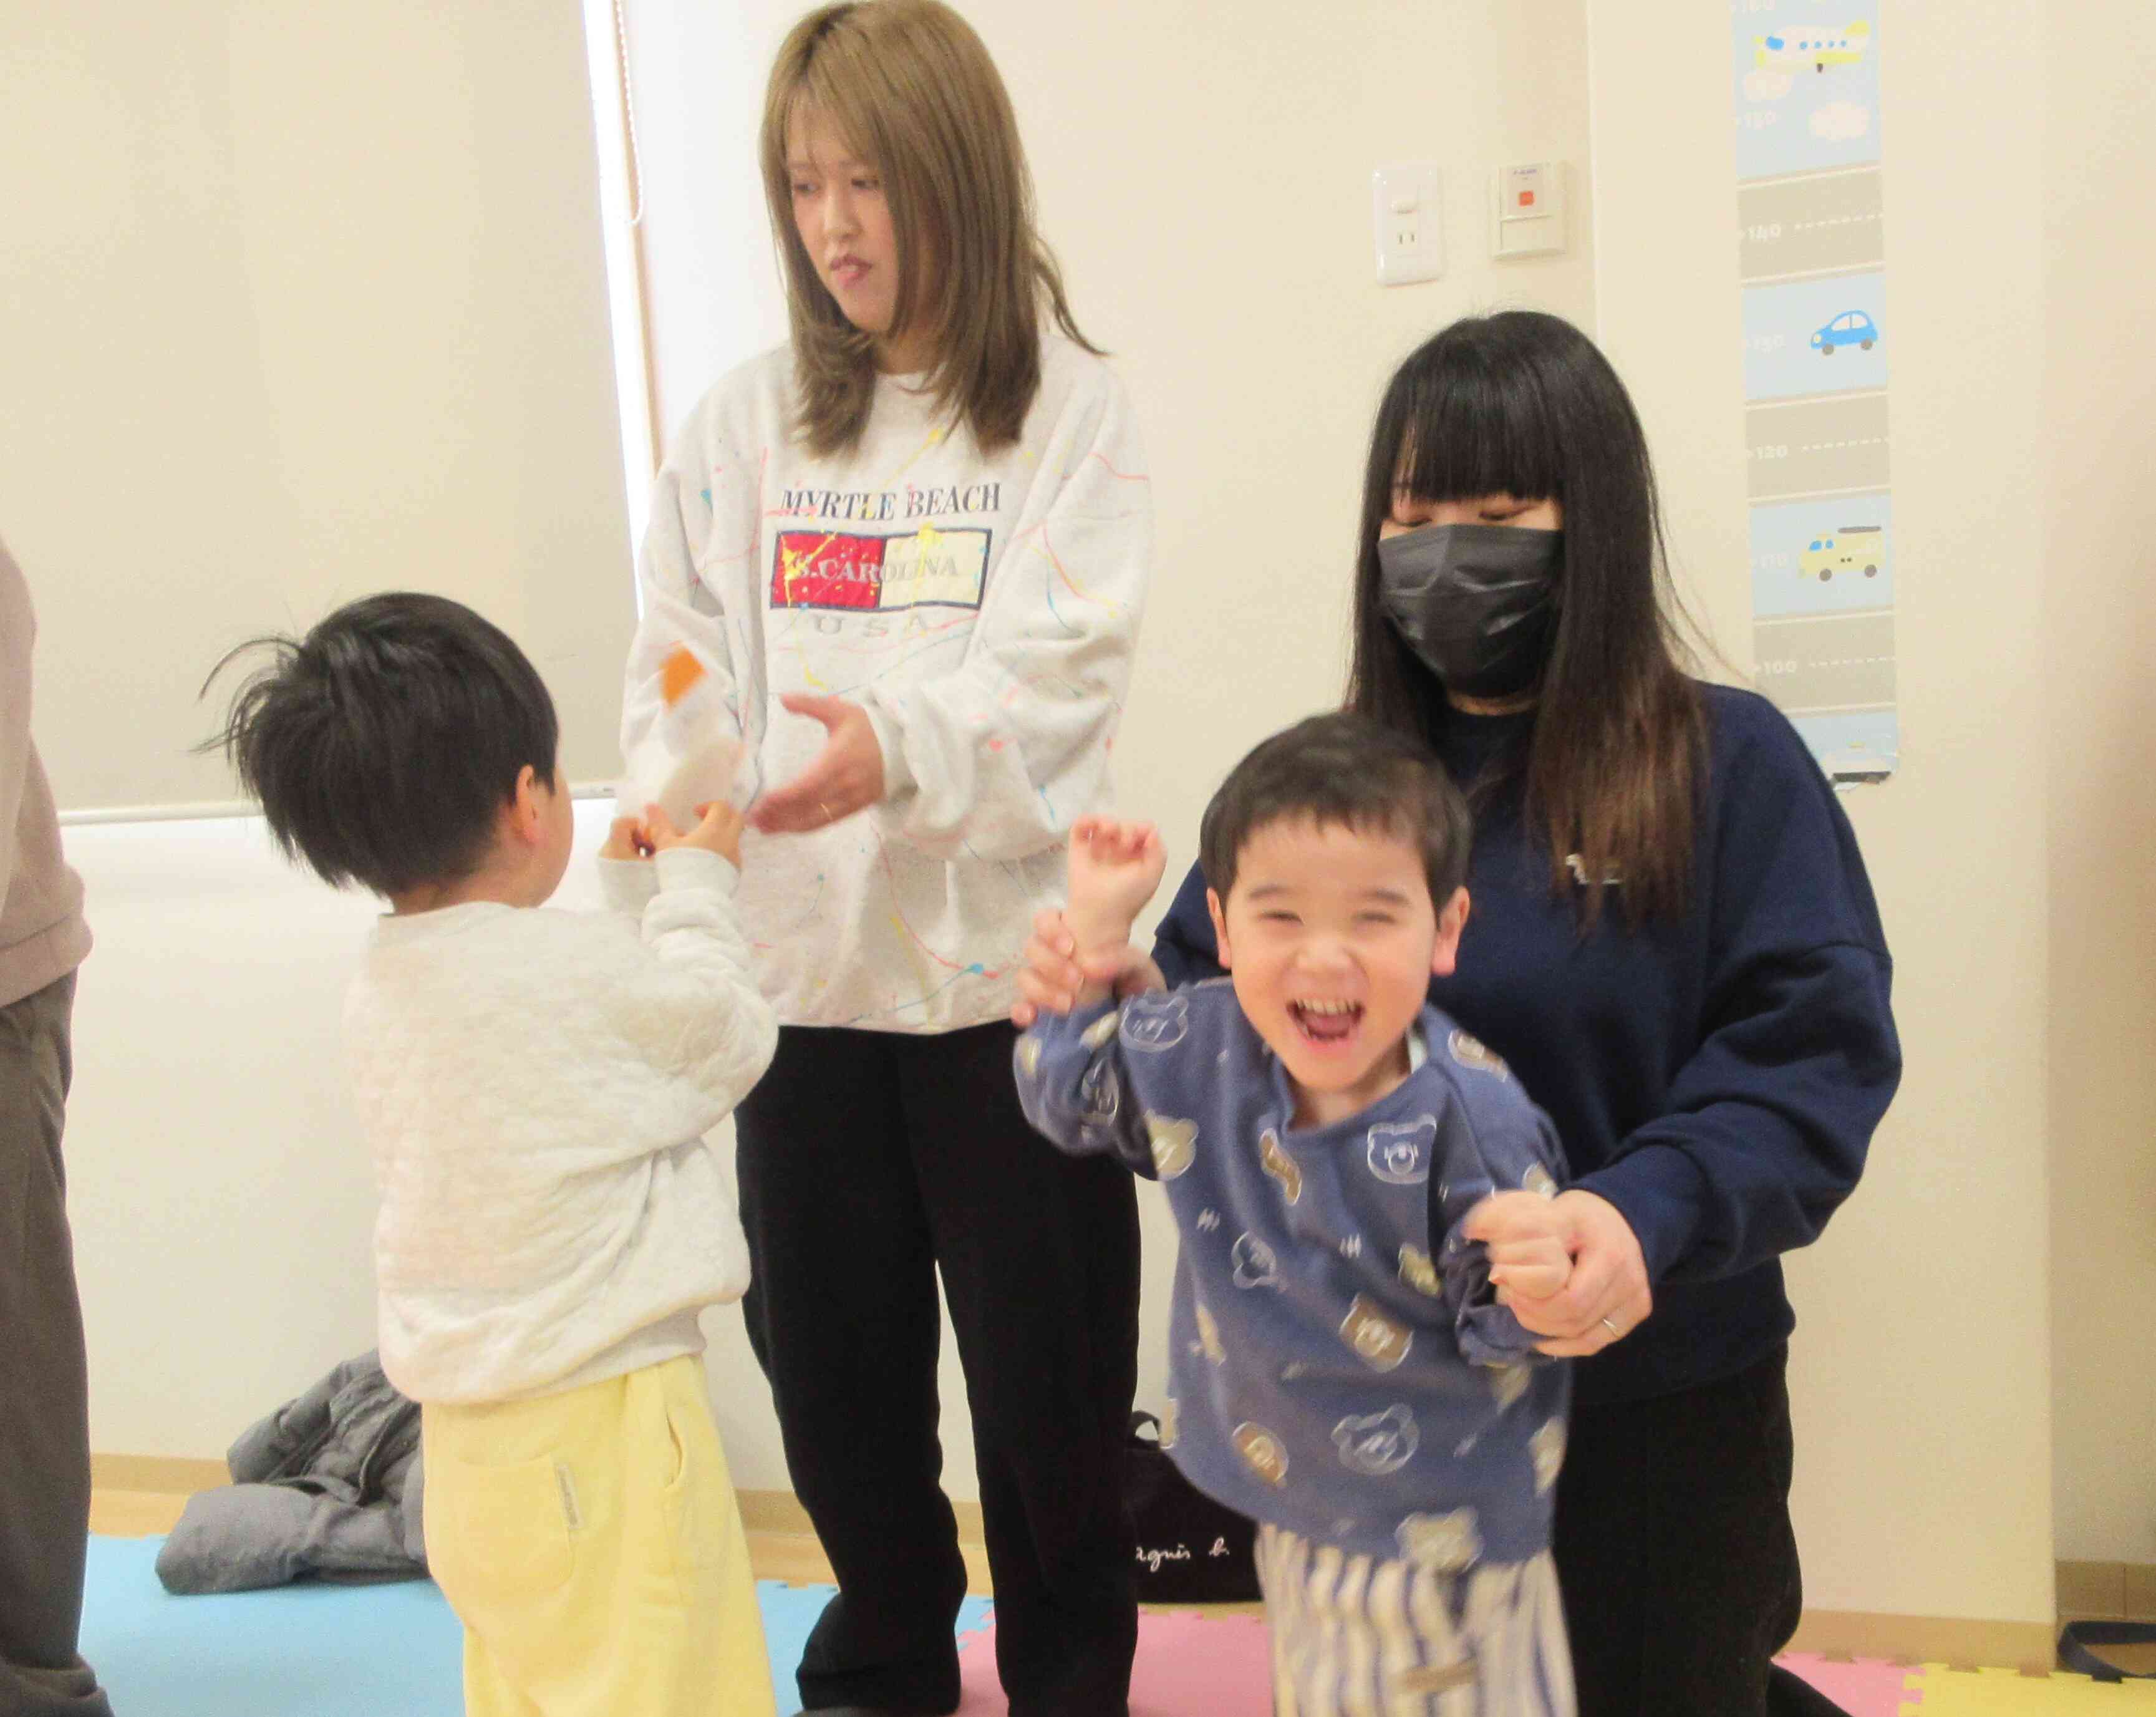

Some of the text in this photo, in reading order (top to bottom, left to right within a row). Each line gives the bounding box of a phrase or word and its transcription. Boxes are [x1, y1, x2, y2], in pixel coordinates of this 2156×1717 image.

[781, 483, 1001, 520] MYRTLE BEACH
[1764, 660, 1797, 675] 100
